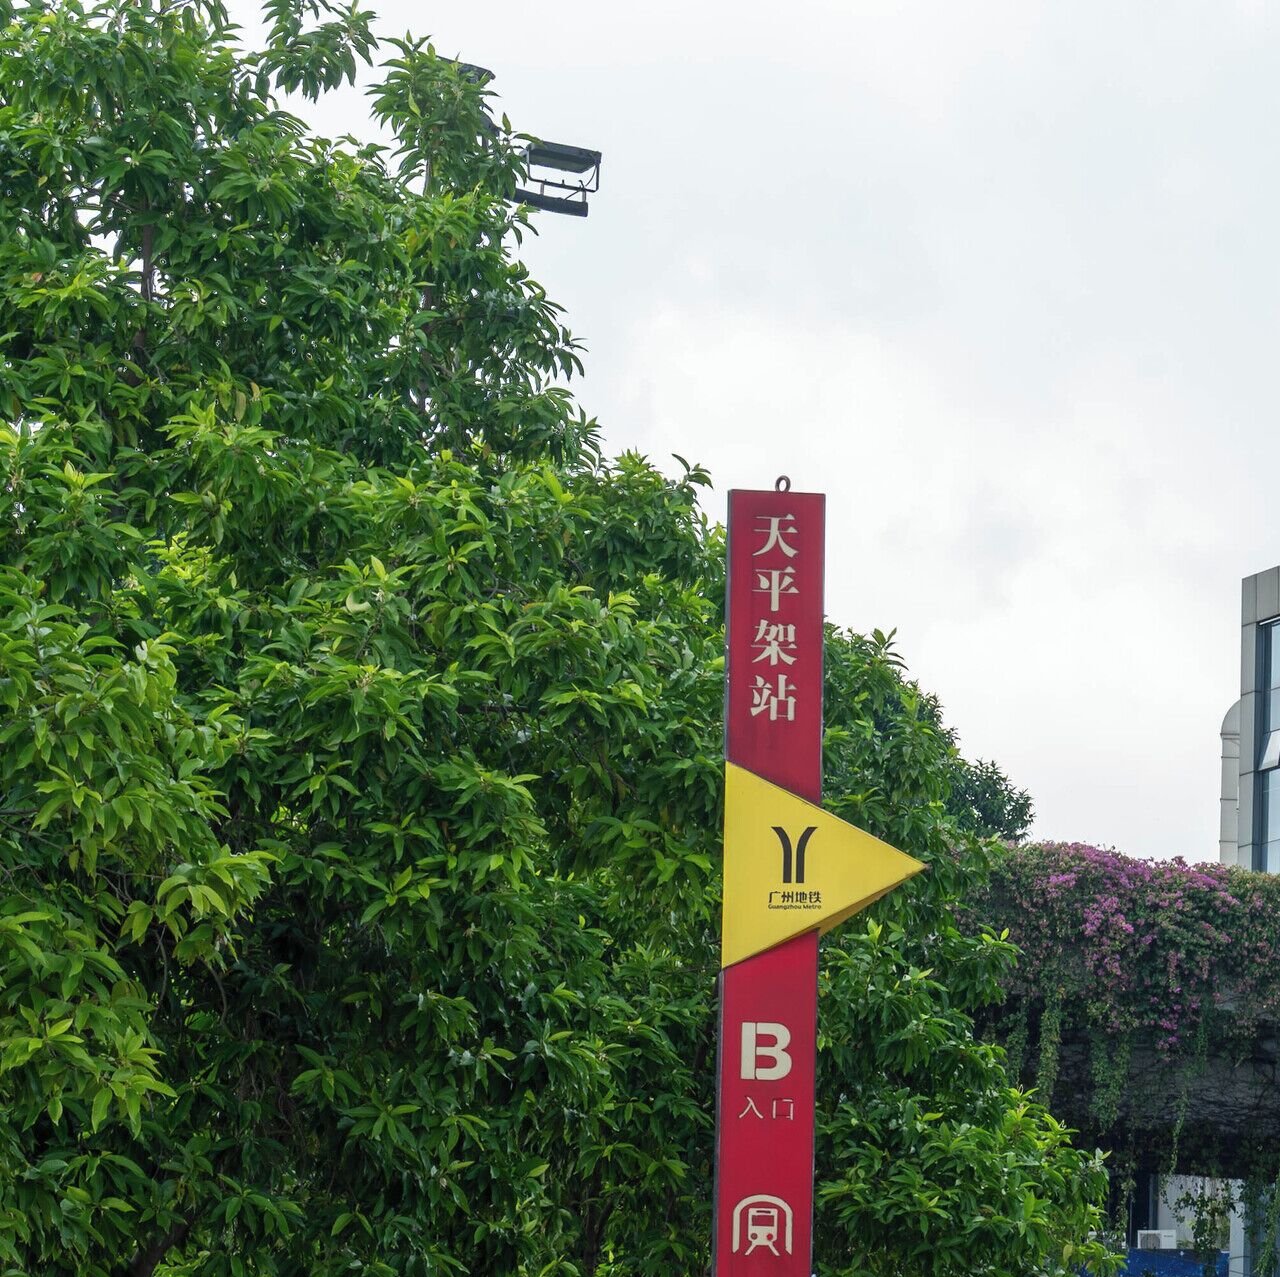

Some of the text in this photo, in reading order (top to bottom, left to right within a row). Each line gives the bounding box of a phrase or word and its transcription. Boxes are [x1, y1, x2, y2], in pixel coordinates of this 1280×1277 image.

[750, 514, 799, 721] 天平架站
[768, 891, 822, 904] 广州地铁
[740, 1021, 793, 1081] B
[739, 1097, 794, 1120] 入口
